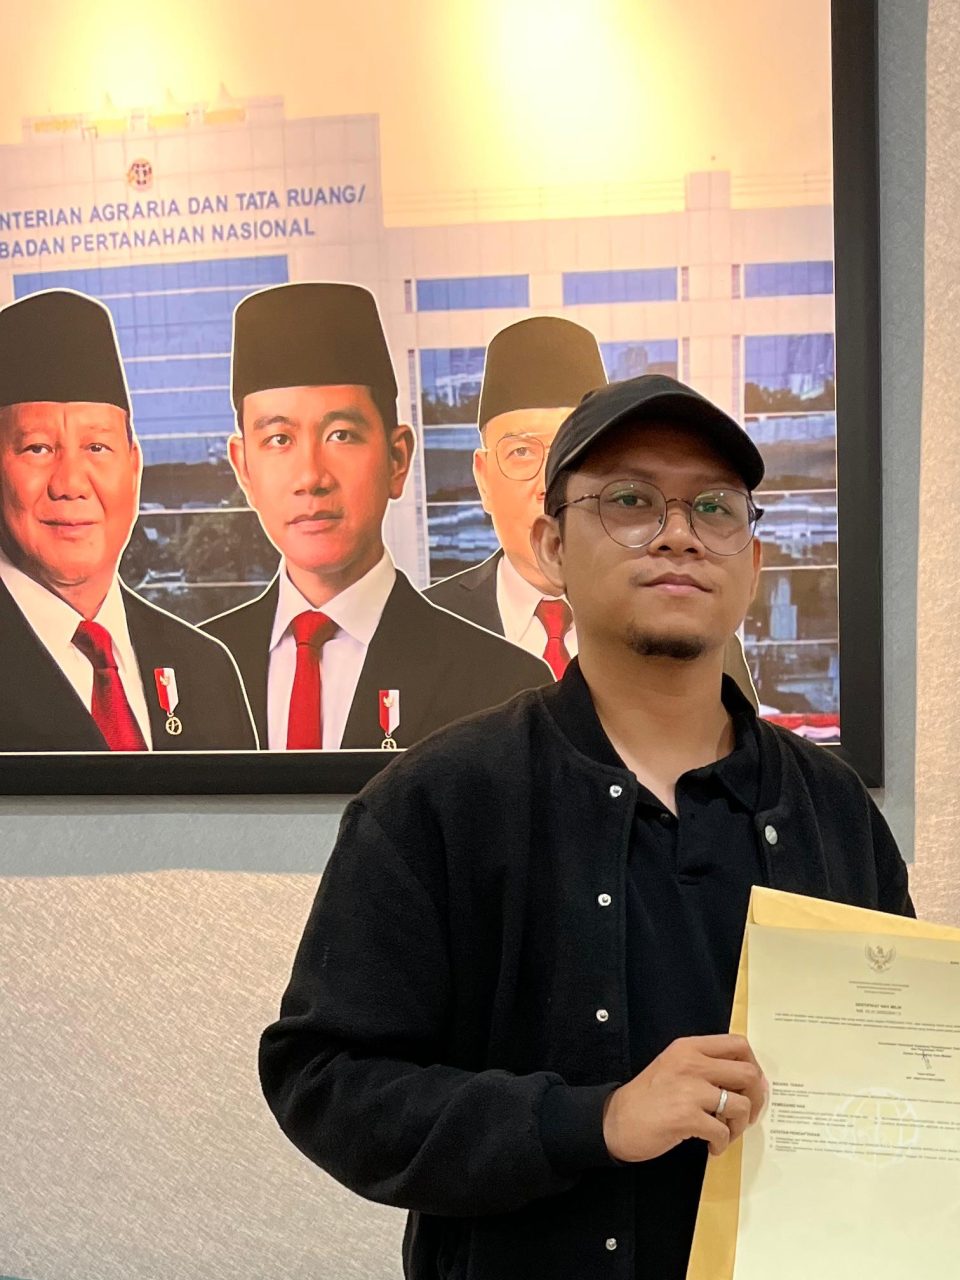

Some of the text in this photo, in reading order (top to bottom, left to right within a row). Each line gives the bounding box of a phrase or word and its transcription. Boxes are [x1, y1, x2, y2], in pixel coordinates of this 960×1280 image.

[90, 199, 180, 223] AGRARIA
[188, 195, 228, 214] DAN
[235, 190, 280, 211] TATA
[286, 184, 366, 207] RUANG/
[0, 218, 315, 259] BADAN PERTANAHAN NASIONAL
